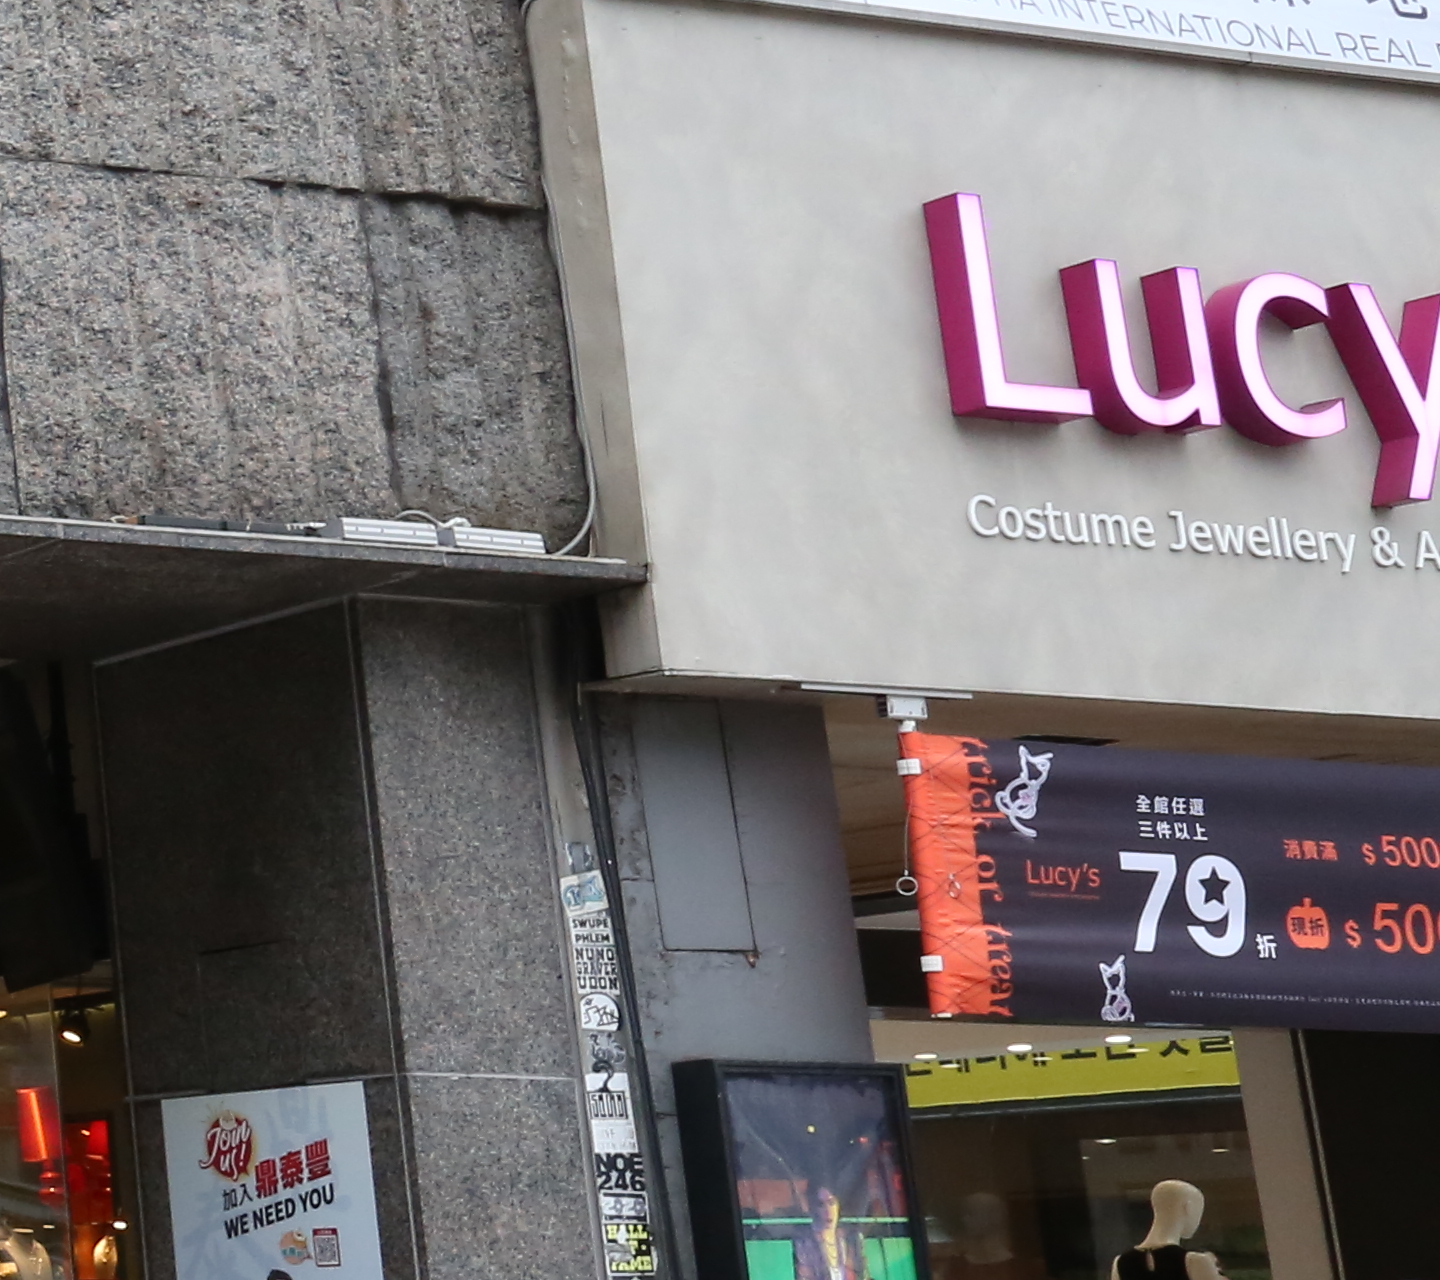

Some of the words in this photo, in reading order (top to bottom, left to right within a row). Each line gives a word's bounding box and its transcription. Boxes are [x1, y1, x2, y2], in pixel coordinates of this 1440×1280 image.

[1337, 31, 1432, 70] REAL
[967, 494, 1155, 550] Costume
[1168, 510, 1356, 574] Jewellery
[1372, 526, 1405, 568] &
[1138, 820, 1208, 841] 三件以上
[1283, 839, 1338, 862] 消費滿
[1026, 859, 1101, 892] Lucy's
[1118, 851, 1247, 958] 79
[1256, 933, 1277, 959] 折
[1373, 903, 1440, 955] 50
[223, 1184, 253, 1212] 加入
[254, 1138, 332, 1200] 鼎泰豐
[224, 1212, 250, 1240] WE
[252, 1196, 296, 1232] NEED
[299, 1182, 335, 1215] YOU
